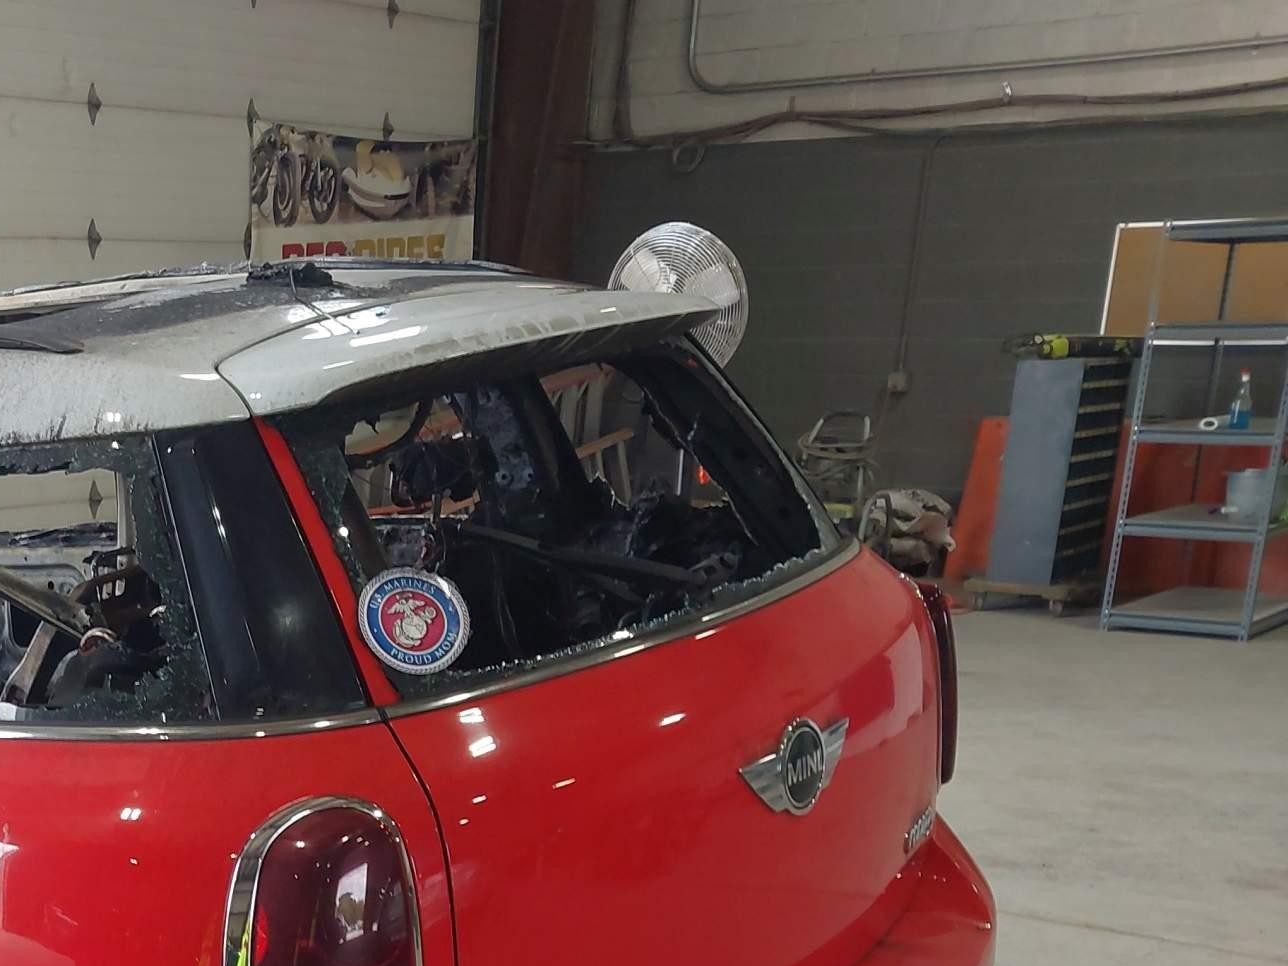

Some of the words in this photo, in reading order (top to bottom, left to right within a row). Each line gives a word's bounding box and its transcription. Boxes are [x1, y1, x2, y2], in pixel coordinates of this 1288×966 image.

[369, 591, 385, 609] U.S.
[383, 578, 436, 594] MARINES
[390, 647, 432, 665] PROUD
[435, 632, 457, 659] MOM
[787, 748, 823, 787] MINI
